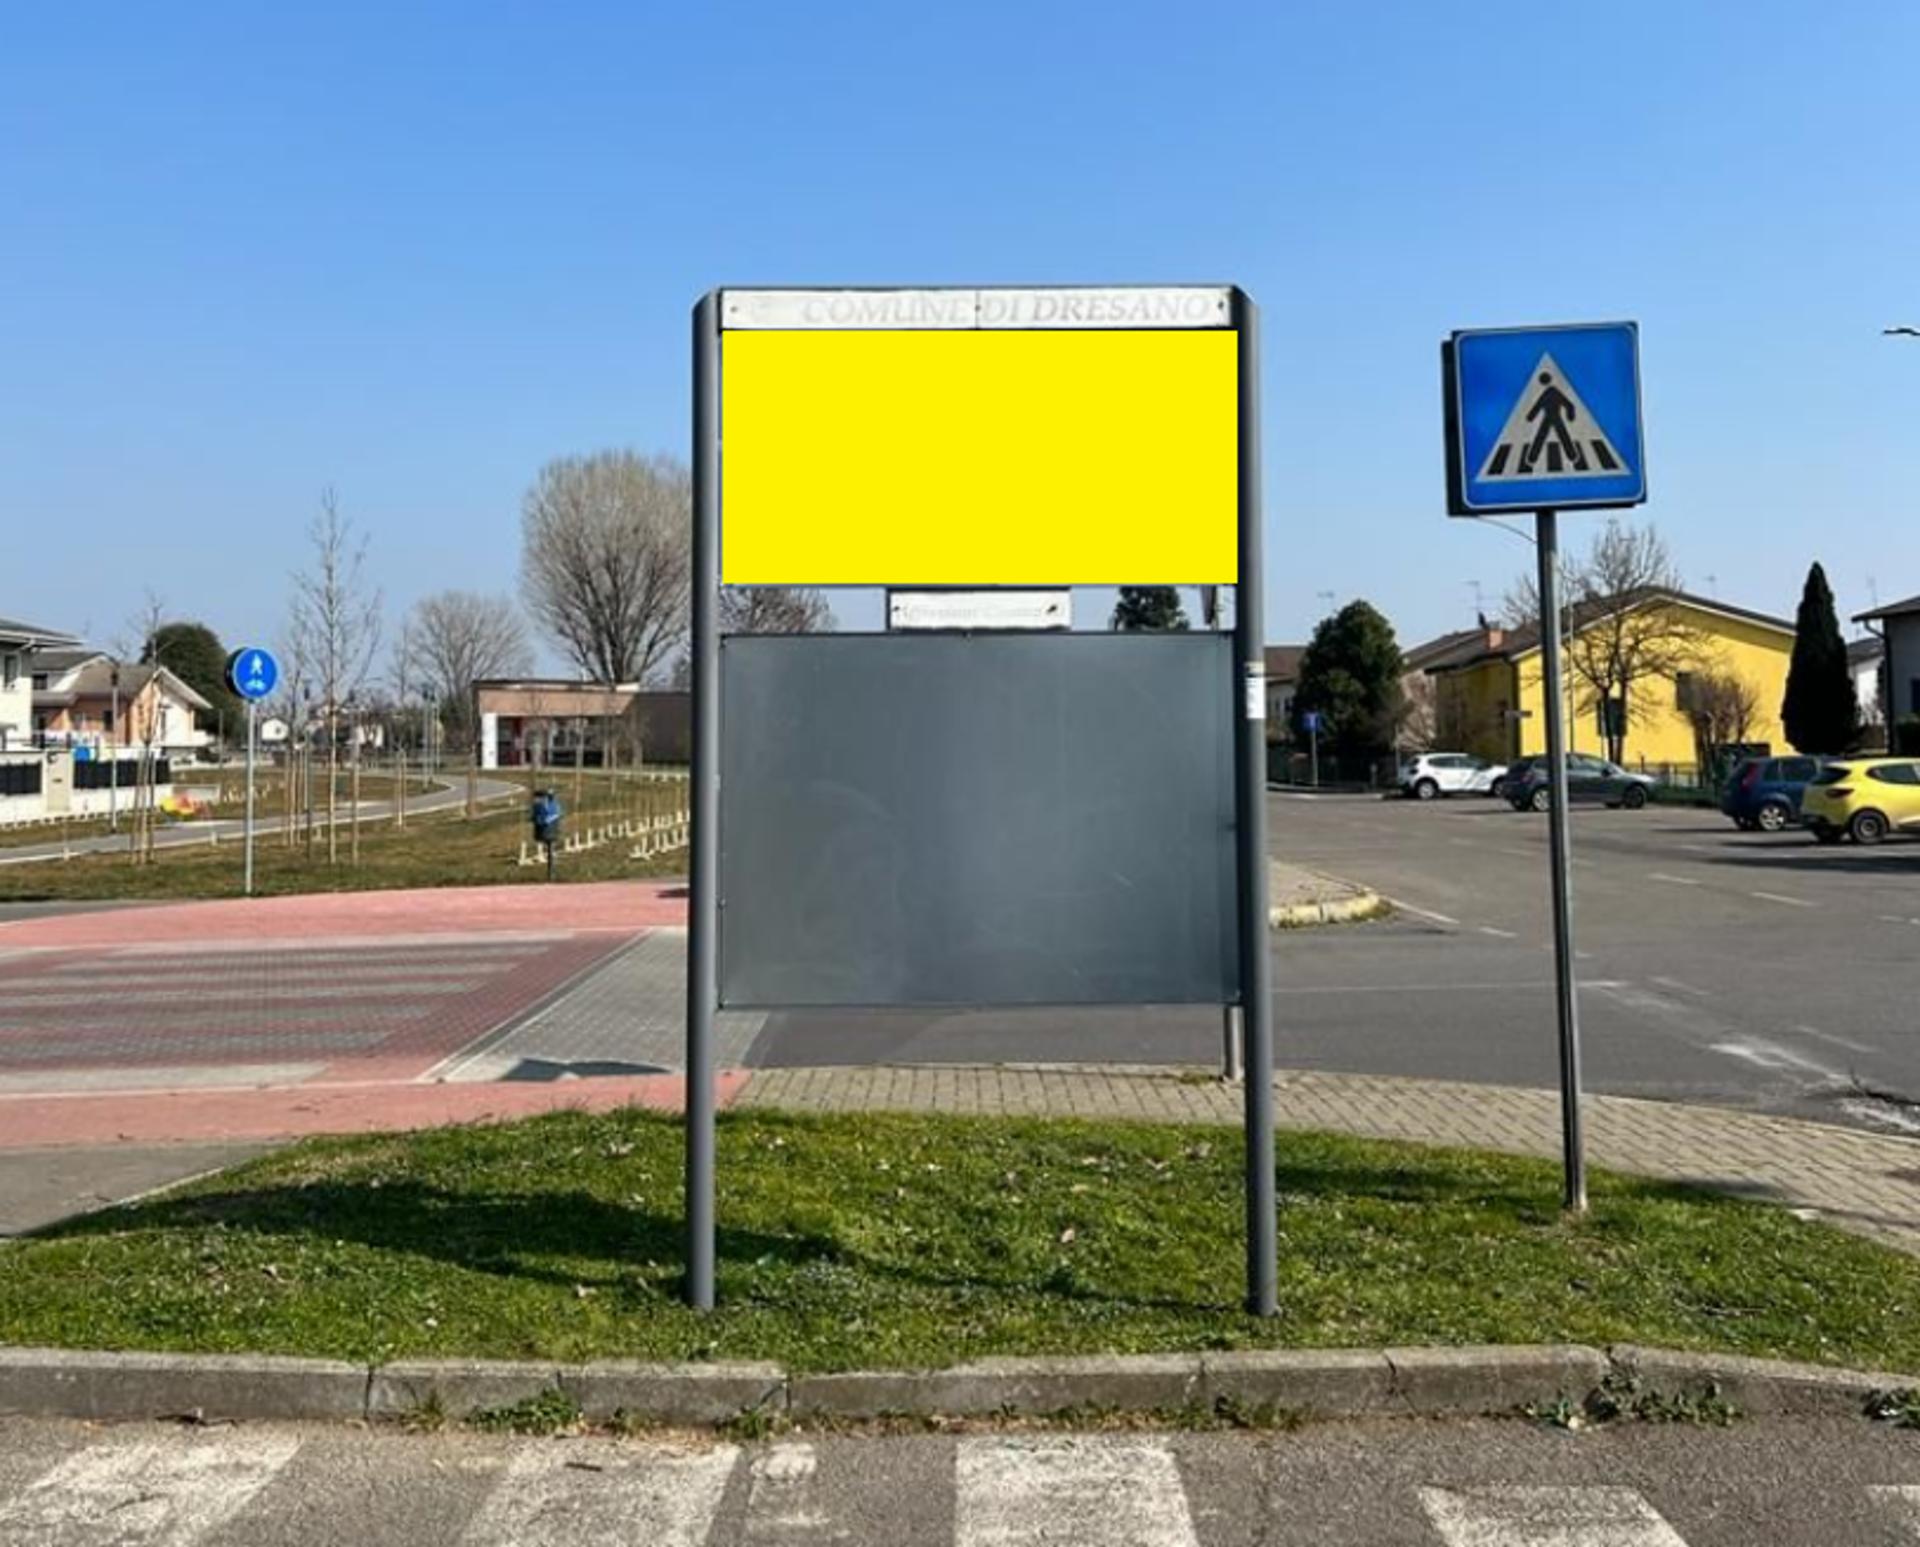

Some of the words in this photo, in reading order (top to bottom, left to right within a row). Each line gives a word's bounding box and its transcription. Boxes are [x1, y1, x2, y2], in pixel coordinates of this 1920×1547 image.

[803, 297, 970, 323] COMUNE
[981, 296, 1022, 322] DI
[1033, 294, 1209, 321] DRESANO
